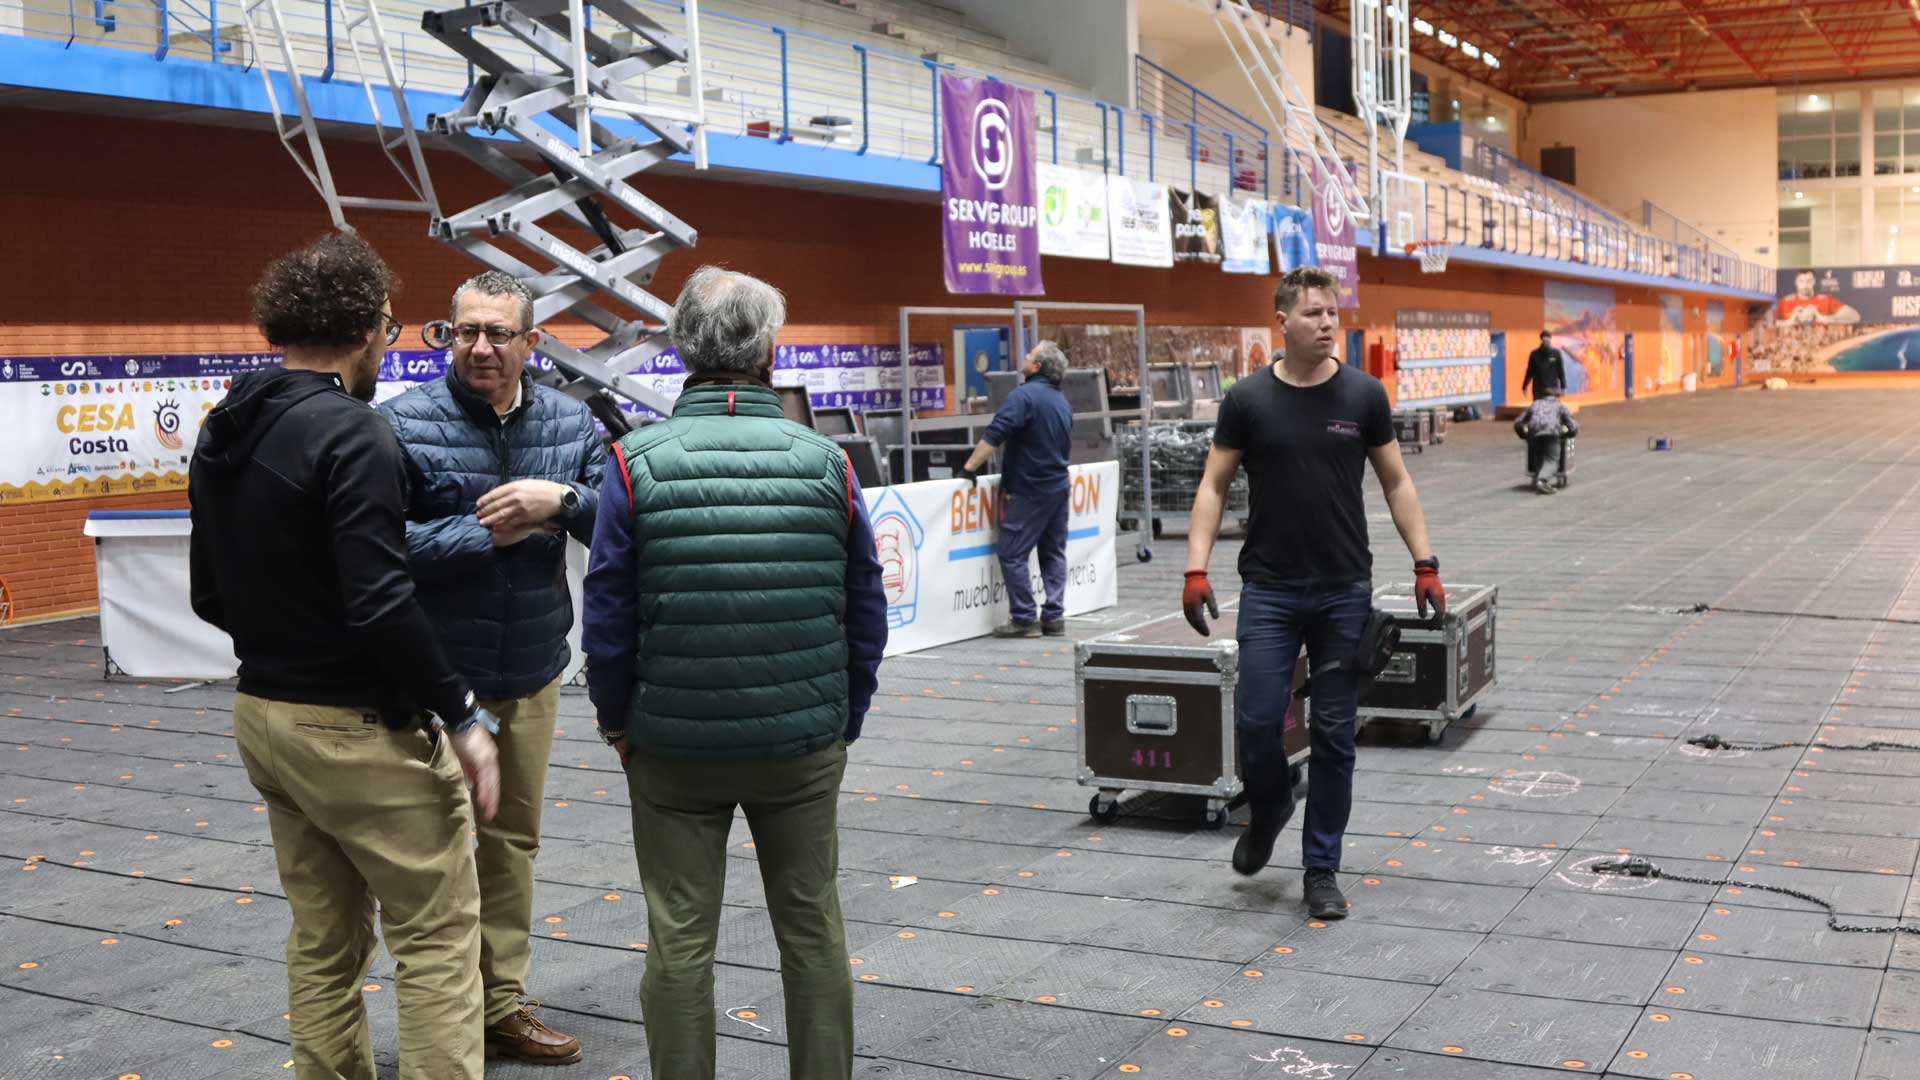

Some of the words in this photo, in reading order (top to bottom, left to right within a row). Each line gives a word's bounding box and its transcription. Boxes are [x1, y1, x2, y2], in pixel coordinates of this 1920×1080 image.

[620, 187, 664, 223] mateco
[549, 241, 597, 277] mateco
[56, 402, 136, 434] CESA
[69, 436, 128, 455] Costa
[1130, 748, 1172, 769] 411
